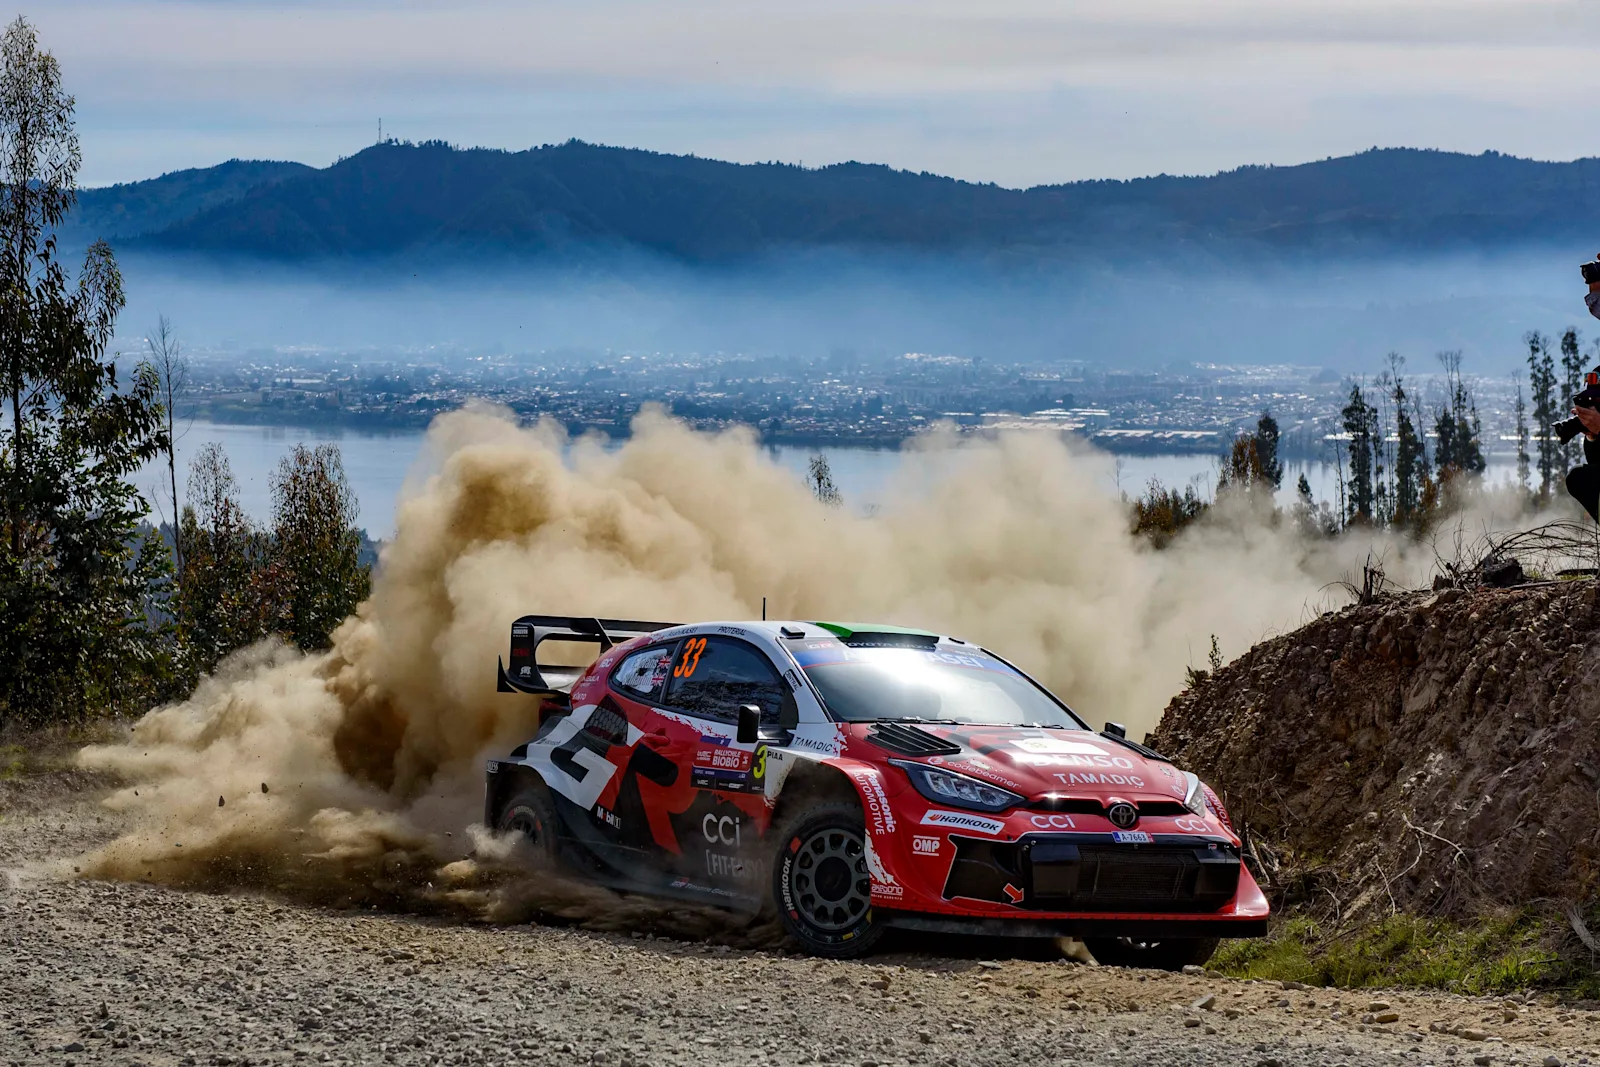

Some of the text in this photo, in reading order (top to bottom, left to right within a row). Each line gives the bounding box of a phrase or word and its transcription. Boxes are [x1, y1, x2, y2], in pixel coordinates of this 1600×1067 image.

[717, 626, 747, 636] PROTERIAL
[673, 637, 707, 678] 33
[784, 669, 798, 691] CENTRAL
[794, 736, 833, 752] TAMADIC
[766, 750, 784, 761] PIAA
[1032, 753, 1134, 770] DENSO
[947, 760, 1021, 788] codebeamer
[1053, 773, 1144, 788] TAMADIC
[853, 772, 885, 835] AUTOMOTIVE
[863, 771, 897, 833] Panasonic
[597, 805, 614, 826] Mobil
[1030, 815, 1076, 829] CCi
[702, 813, 741, 847] CCi
[912, 838, 940, 853] OMP
